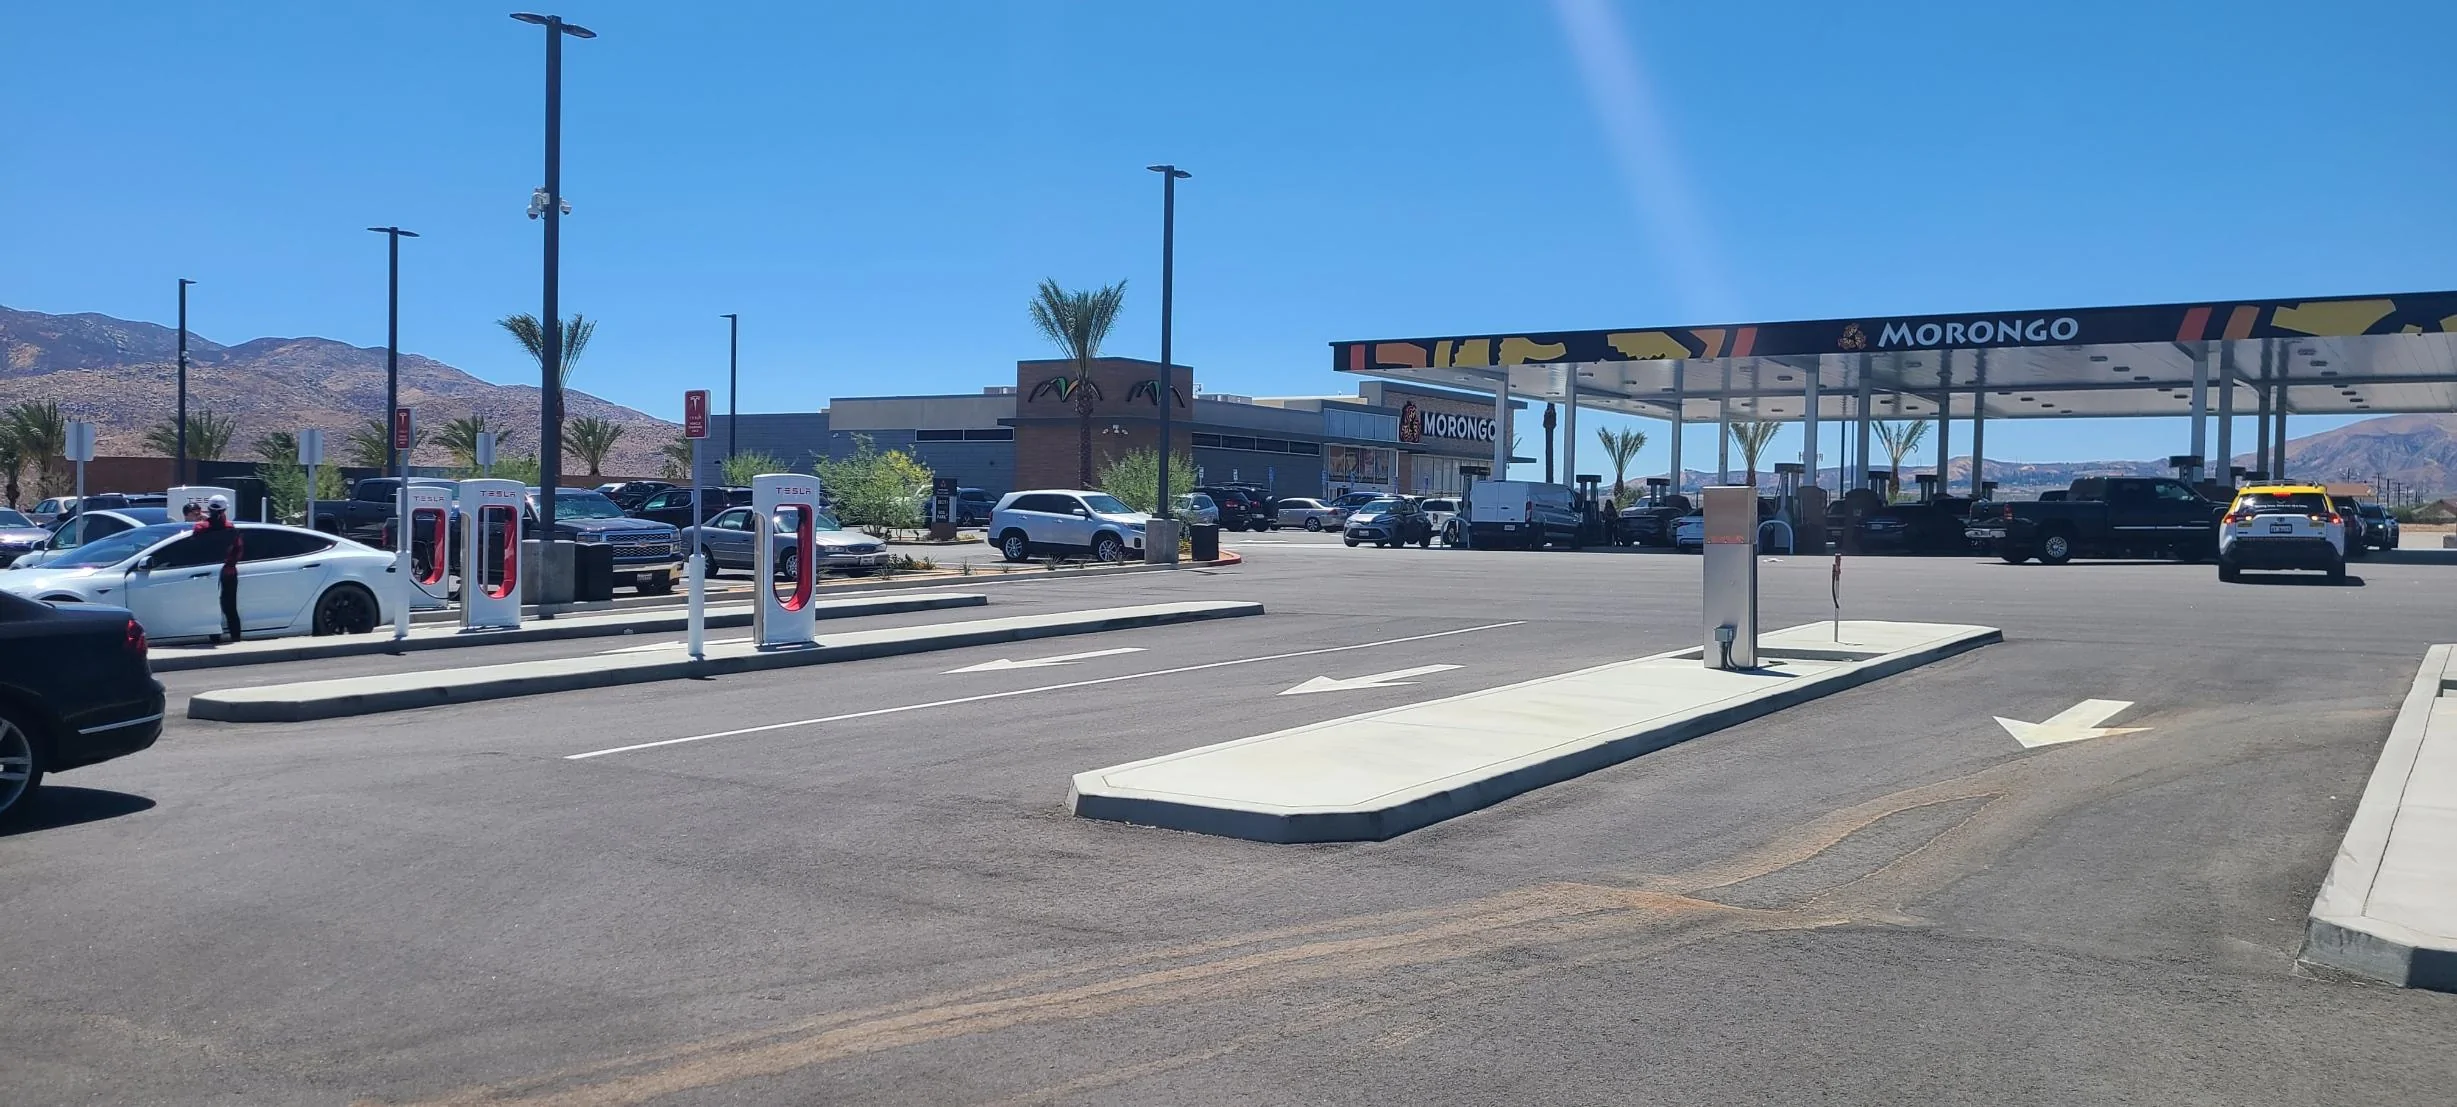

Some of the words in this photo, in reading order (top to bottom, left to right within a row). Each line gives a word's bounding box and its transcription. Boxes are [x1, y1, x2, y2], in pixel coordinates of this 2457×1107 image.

[1877, 317, 2079, 347] MORONGO
[1423, 412, 1496, 441] MORONGO
[480, 490, 516, 498] TESLA
[775, 487, 812, 495] TESLA
